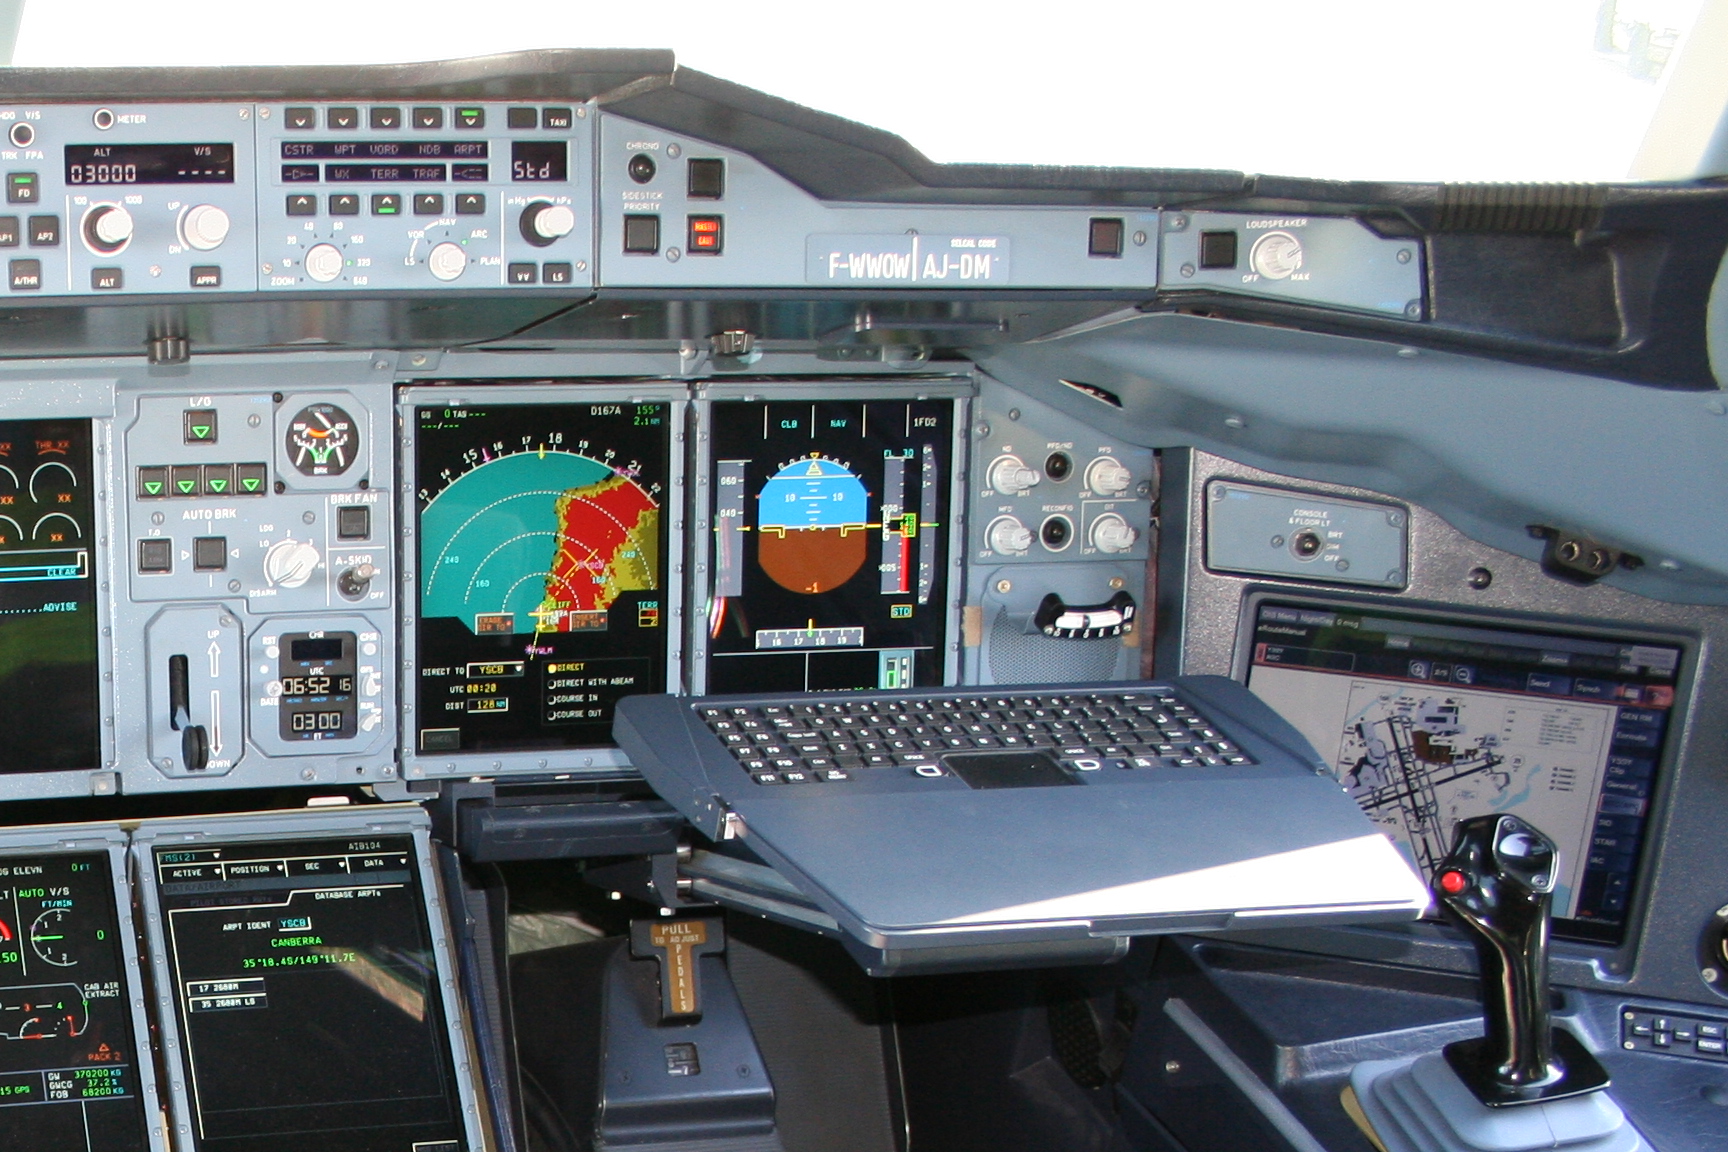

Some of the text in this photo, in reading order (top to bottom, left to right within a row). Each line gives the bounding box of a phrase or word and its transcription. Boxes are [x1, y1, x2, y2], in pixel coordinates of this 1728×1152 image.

[117, 115, 146, 124] METER
[284, 145, 481, 155] CSTR ARPT
[626, 142, 660, 150] CHRONO
[2, 151, 43, 160] TRK FPA
[94, 148, 111, 156] ALT
[72, 165, 136, 182] 03000
[371, 169, 440, 178] TERR TRAF
[1245, 219, 1308, 230] LOUDSPEAKER
[829, 253, 990, 279] F-WWOW AJ-DM
[100, 278, 114, 287] ALT
[190, 398, 211, 406] L/G
[914, 418, 936, 427] 1FD2
[330, 494, 377, 504] BRK FAN
[183, 509, 237, 520] AUTO BRK
[892, 606, 910, 616] STD
[207, 631, 220, 639] UP
[282, 677, 330, 695] 06:52
[207, 760, 230, 769] OWN
[172, 865, 269, 877] ACTIVE POSITION
[18, 888, 44, 898] AUTO
[270, 936, 322, 948] CANBERRA
